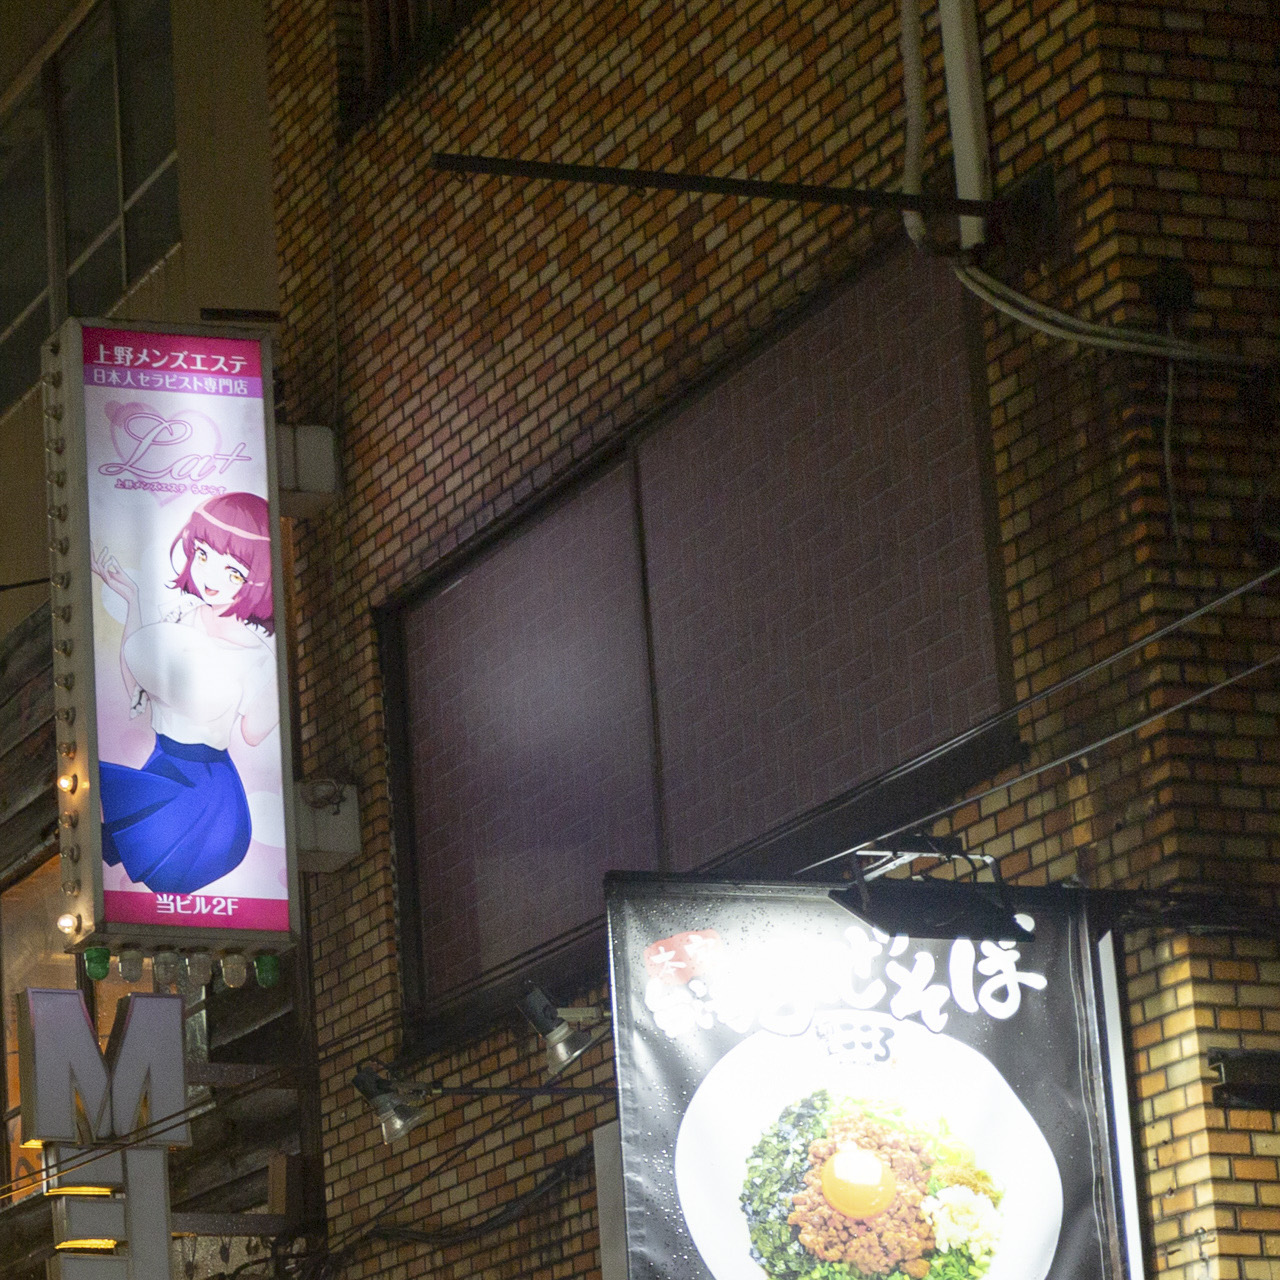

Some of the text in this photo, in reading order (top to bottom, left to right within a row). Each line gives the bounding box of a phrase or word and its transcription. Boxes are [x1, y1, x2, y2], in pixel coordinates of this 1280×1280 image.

[93, 344, 248, 374] 上野メンズエステ
[93, 368, 248, 395] 日本人セラピスト専門店
[156, 894, 240, 917] 当ビル2F
